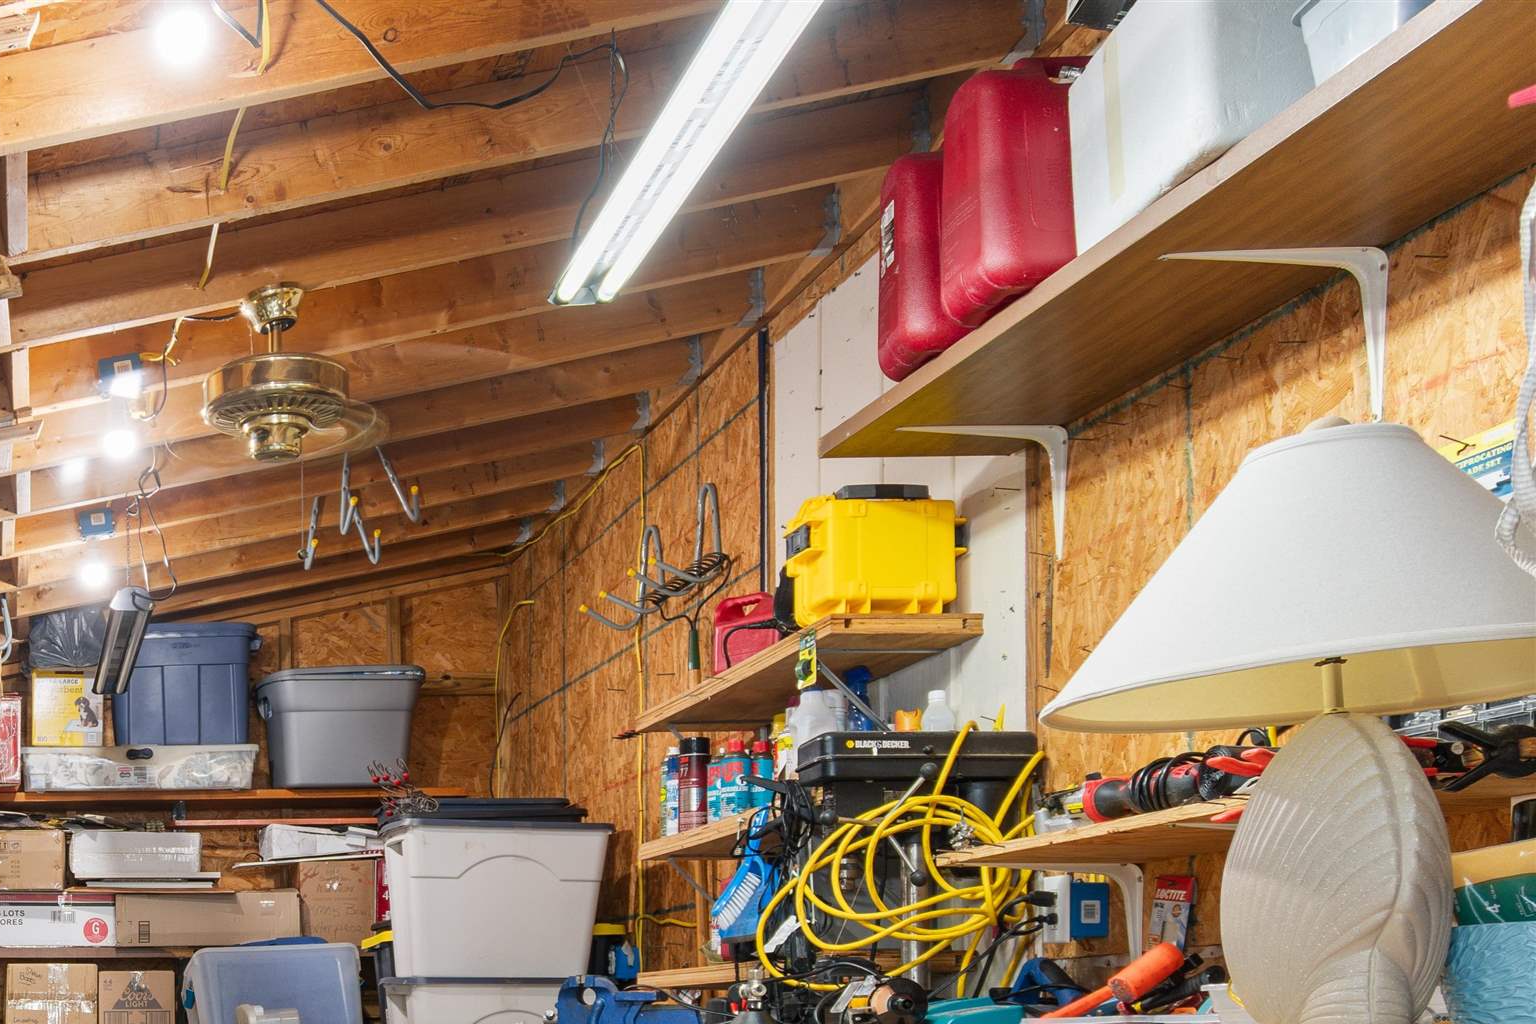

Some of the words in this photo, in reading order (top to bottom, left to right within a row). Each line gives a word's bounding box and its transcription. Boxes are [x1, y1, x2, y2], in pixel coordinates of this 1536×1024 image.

[1155, 888, 1187, 901] LOCTITE
[3, 909, 25, 917] LOTS
[92, 921, 100, 935] G
[124, 1000, 148, 1008] LIGHT
